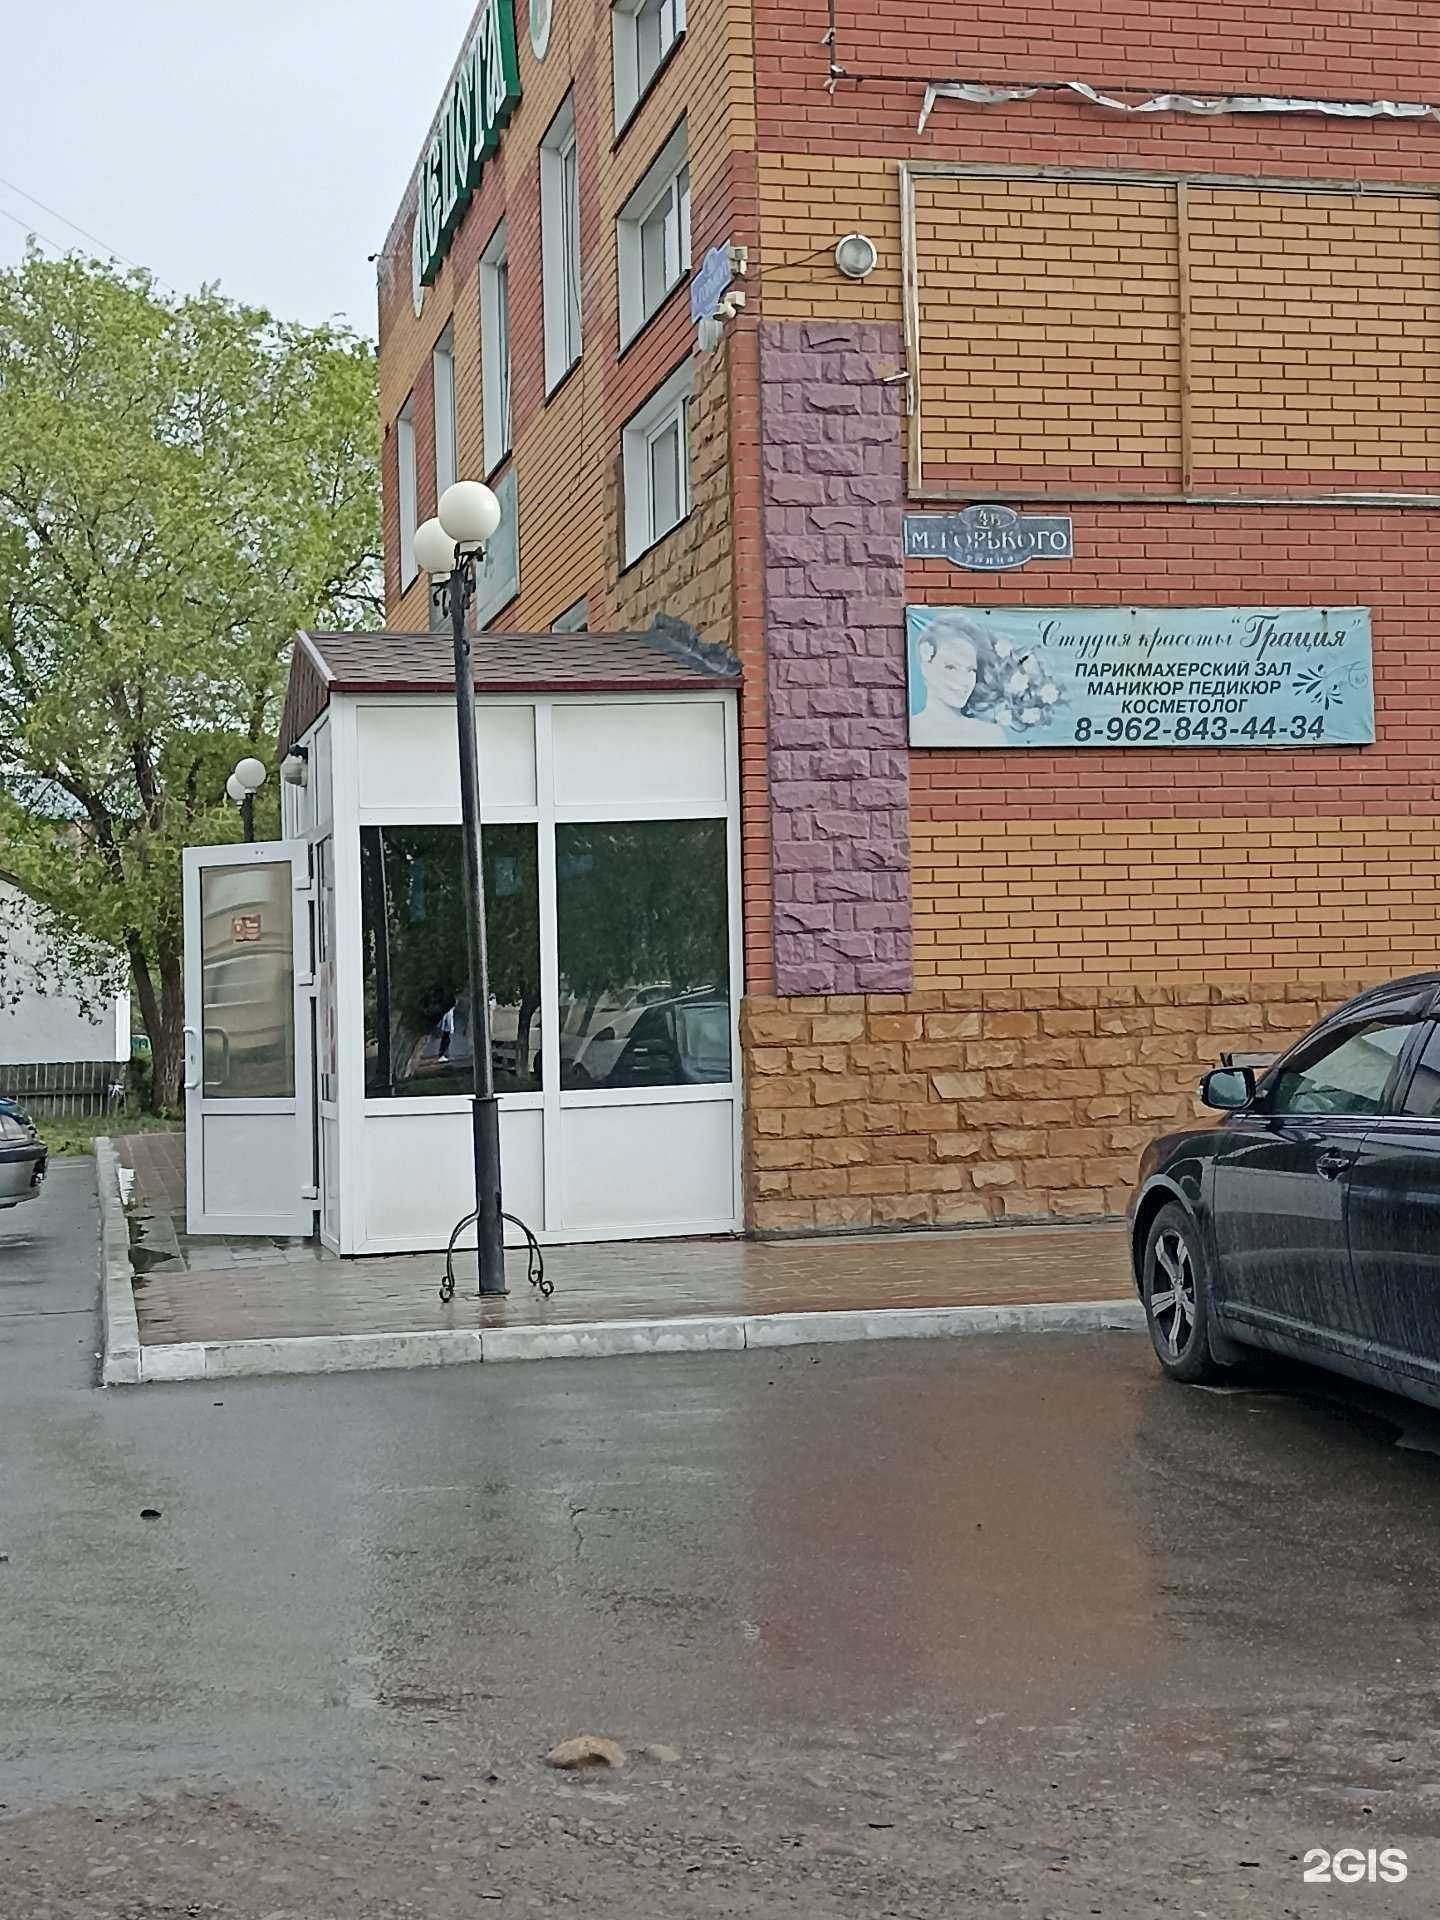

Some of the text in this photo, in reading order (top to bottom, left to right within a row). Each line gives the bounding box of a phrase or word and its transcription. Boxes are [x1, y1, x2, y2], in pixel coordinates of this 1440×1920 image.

[1038, 620, 1131, 659] Студия
[1138, 627, 1232, 658] красоты
[1075, 661, 1292, 677] ПАРИКМАХЕРСКИЙ ЗАЛ
[1087, 680, 1282, 697] МАНИКЮР ПЕДИКЮР
[1121, 698, 1248, 714] КОСМЕТОЛОГ
[1074, 715, 1325, 742] 8-962-843-44-34
